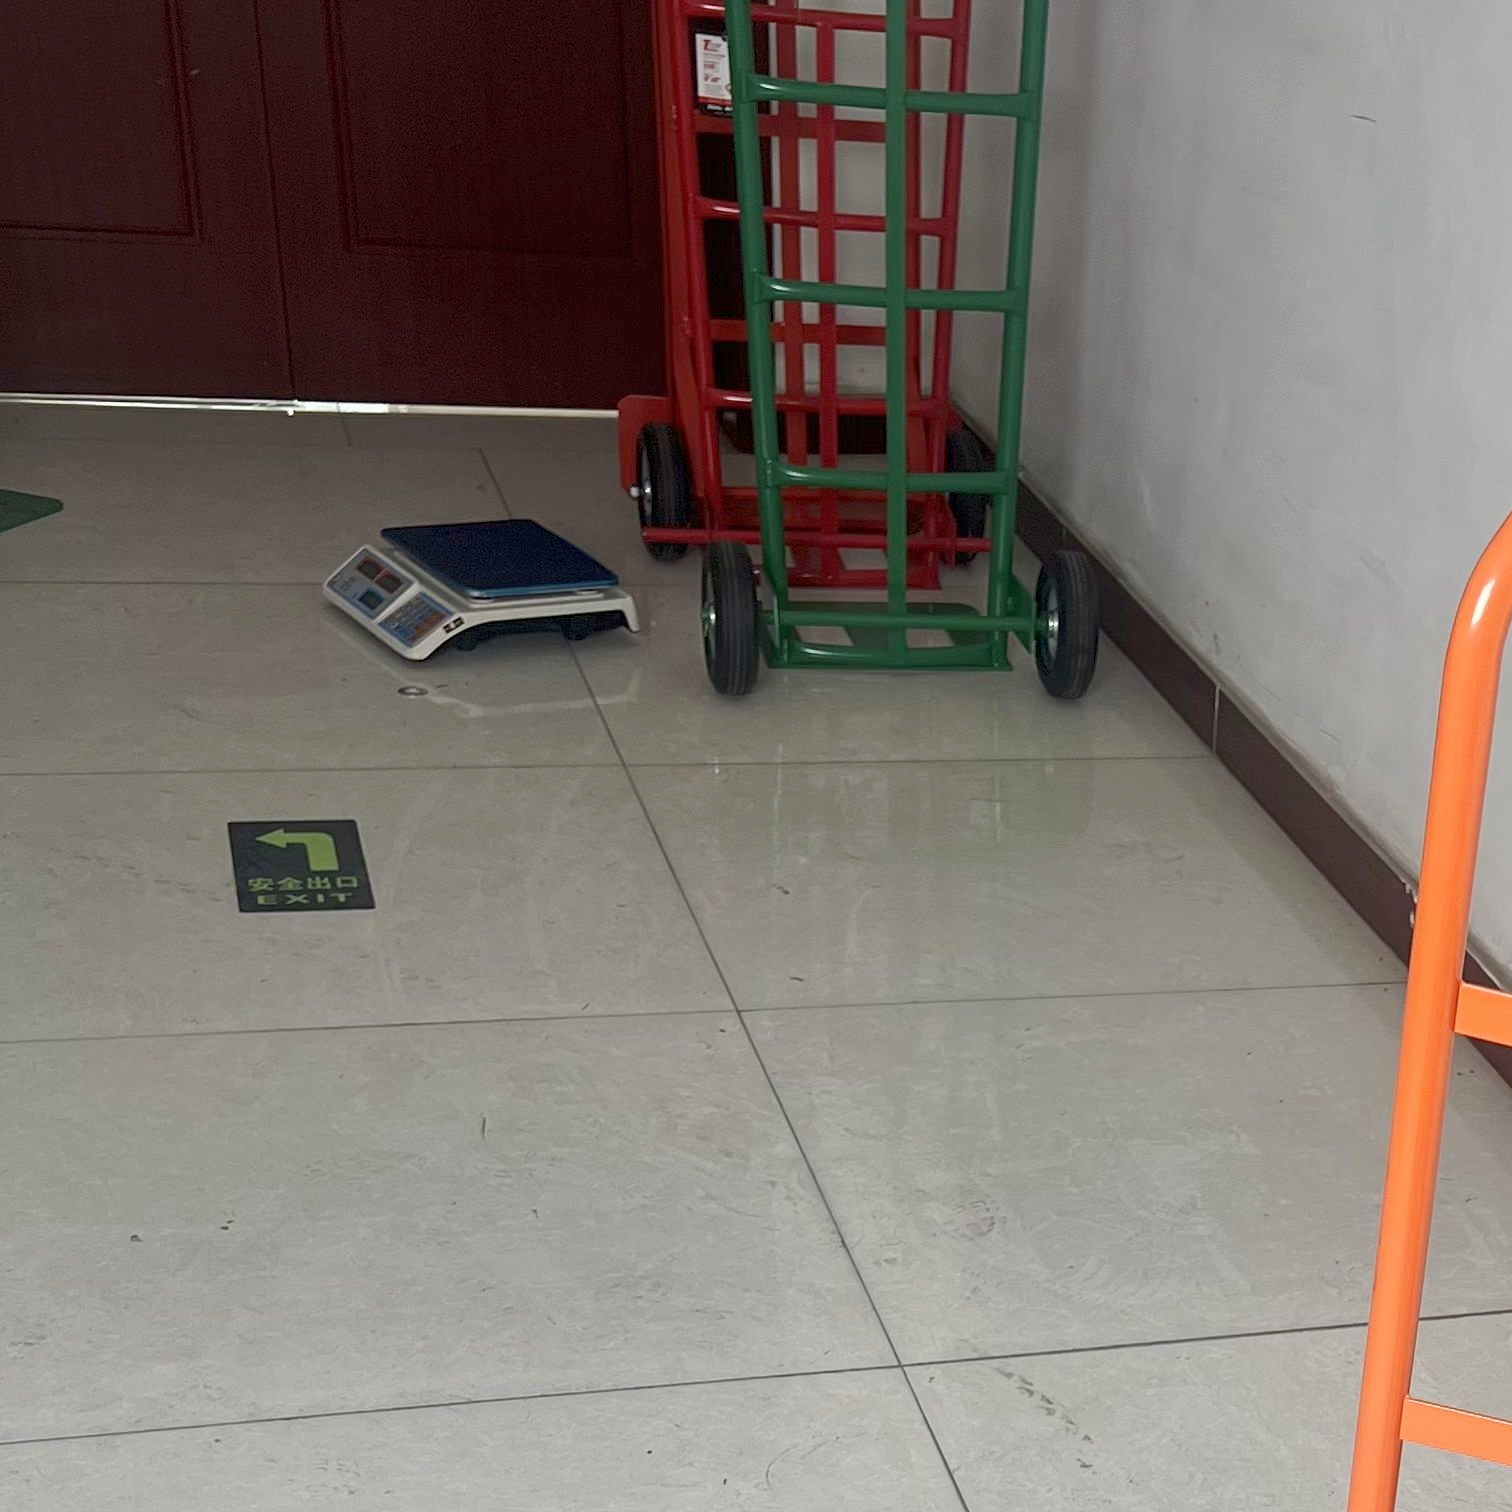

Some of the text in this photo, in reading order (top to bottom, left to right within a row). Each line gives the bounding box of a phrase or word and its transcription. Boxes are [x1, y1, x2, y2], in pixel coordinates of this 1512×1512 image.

[248, 876, 358, 891] 安全出口
[256, 892, 352, 905] EXIT
